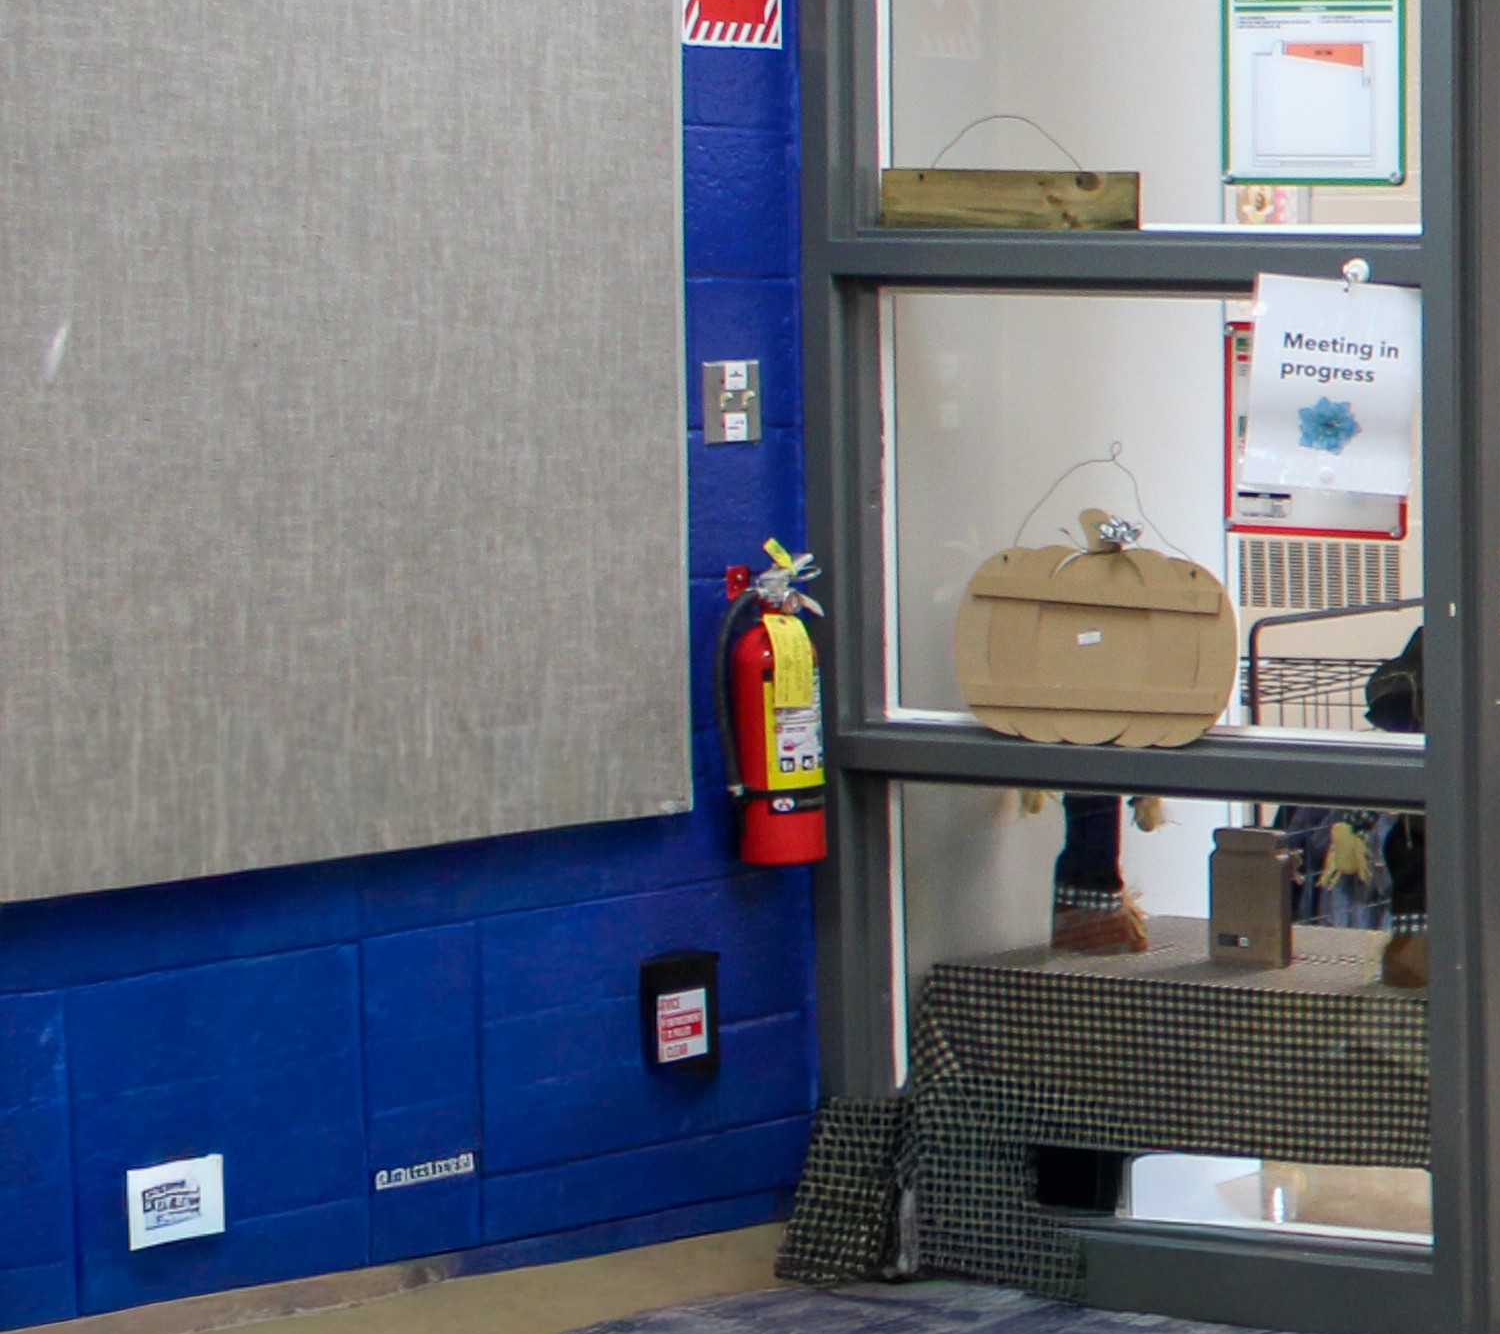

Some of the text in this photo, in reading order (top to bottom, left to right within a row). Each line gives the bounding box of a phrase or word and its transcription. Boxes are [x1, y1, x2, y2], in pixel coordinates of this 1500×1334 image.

[1282, 331, 1400, 361] Meeting in
[1279, 361, 1376, 384] progress
